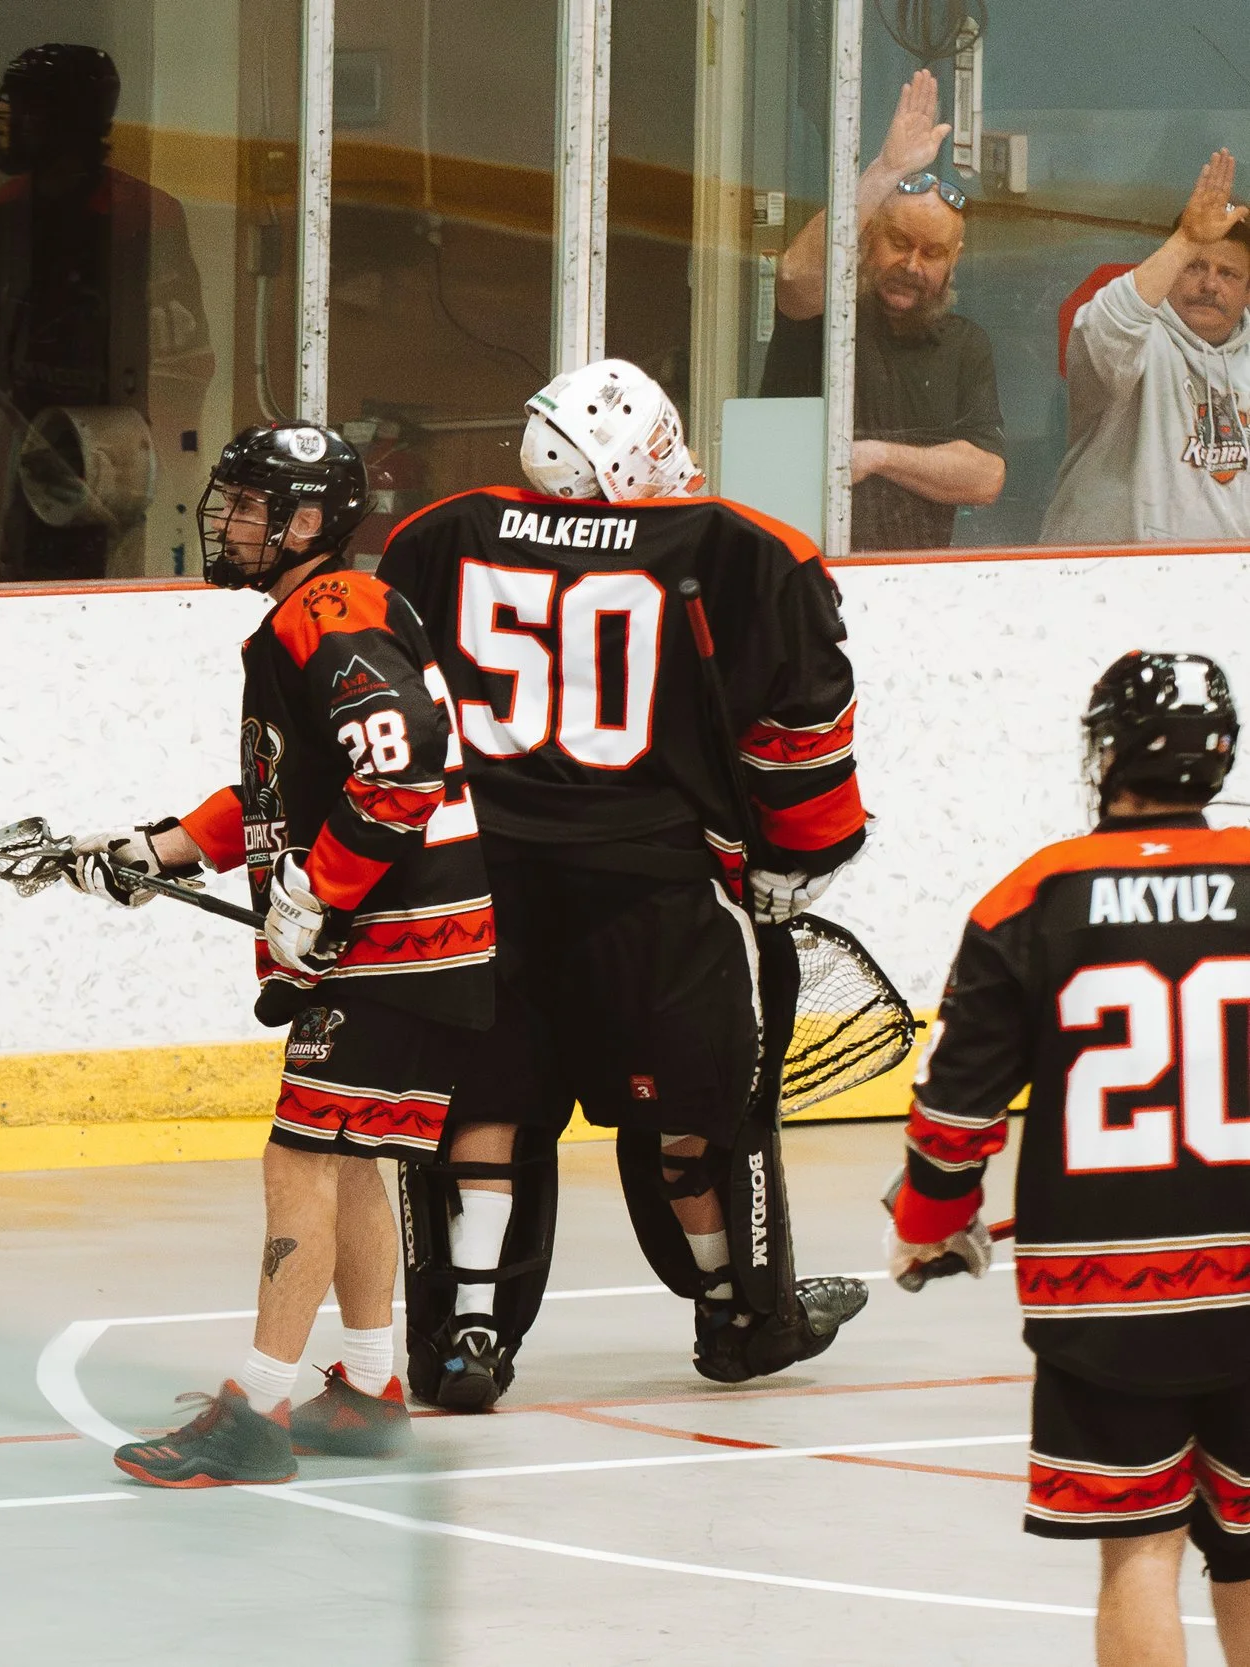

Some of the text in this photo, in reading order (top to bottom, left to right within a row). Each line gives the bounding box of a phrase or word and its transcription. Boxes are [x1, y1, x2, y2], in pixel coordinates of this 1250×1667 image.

[290, 482, 327, 493] CCM
[499, 508, 637, 550] DALKEITH
[457, 556, 666, 771] 50
[337, 709, 410, 777] 28
[1088, 873, 1237, 925] AKYUZ
[1057, 955, 1250, 1176] 20
[748, 1151, 768, 1268] BODDAM
